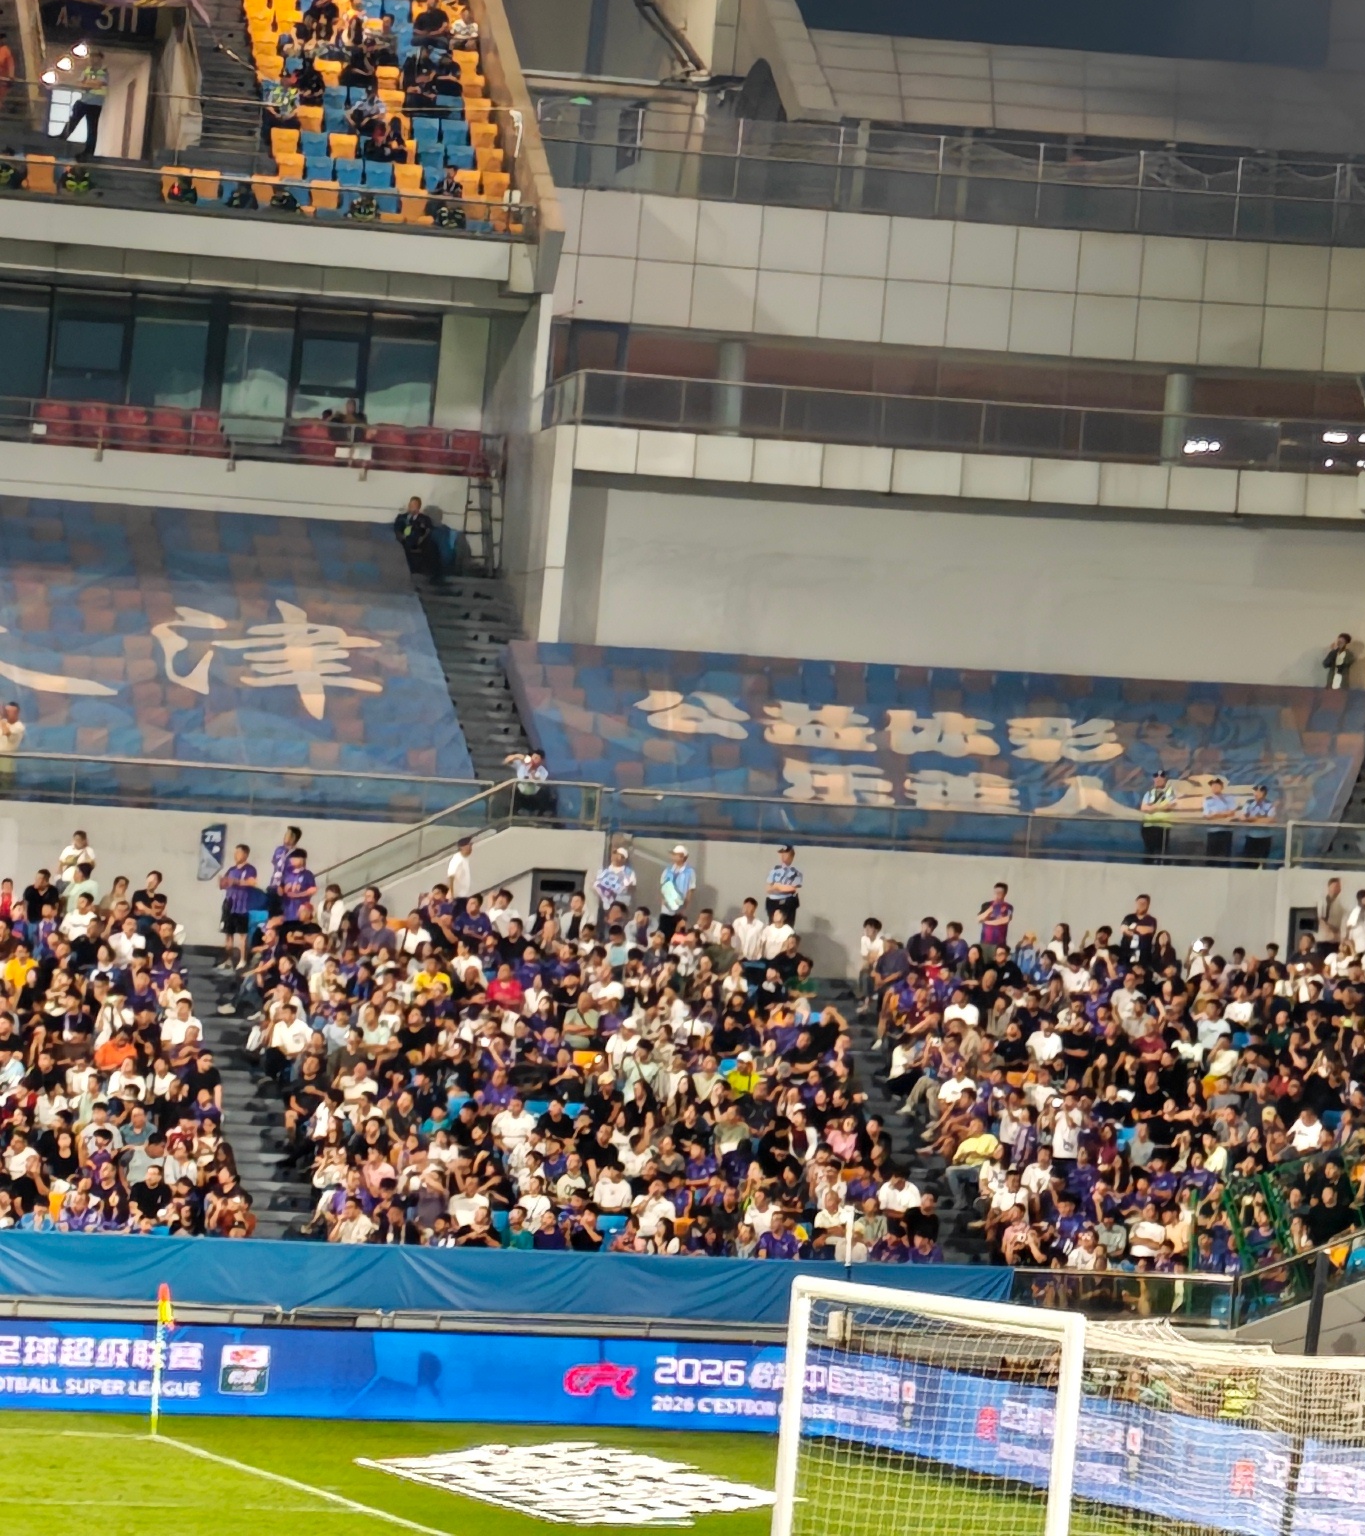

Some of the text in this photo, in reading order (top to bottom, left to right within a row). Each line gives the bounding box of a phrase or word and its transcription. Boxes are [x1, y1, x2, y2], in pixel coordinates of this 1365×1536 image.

[634, 690, 1124, 763] 公益体彩
[655, 1356, 747, 1386] 2026
[65, 1378, 125, 1396] SUPER
[652, 1396, 695, 1413] 2026
